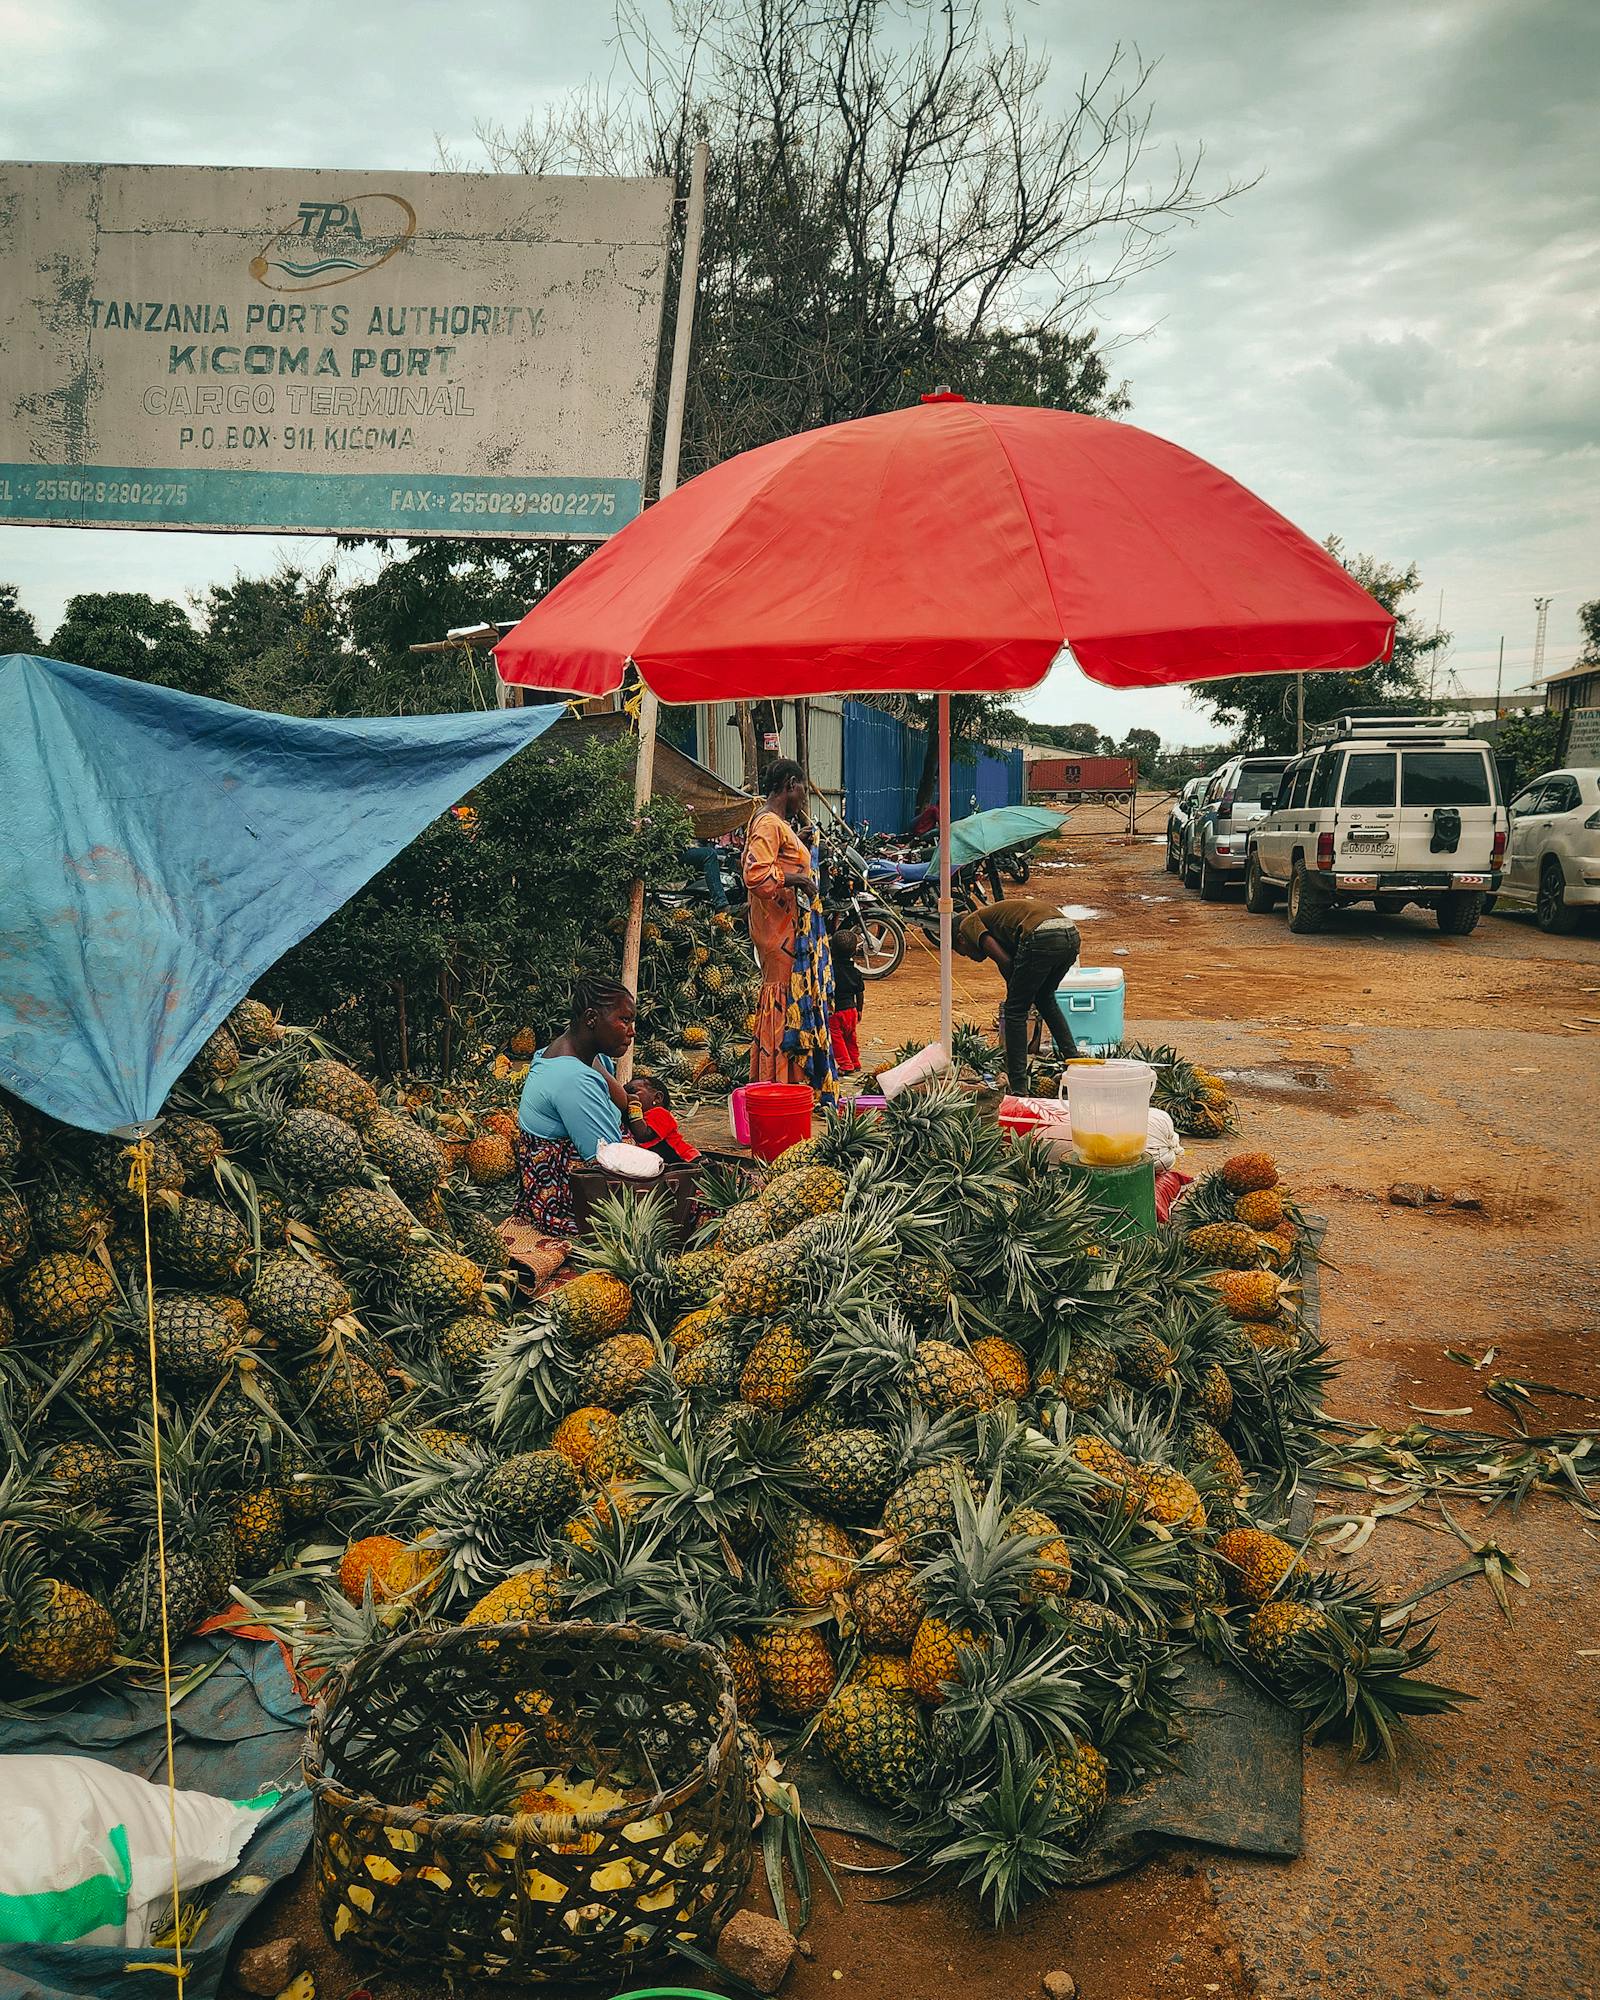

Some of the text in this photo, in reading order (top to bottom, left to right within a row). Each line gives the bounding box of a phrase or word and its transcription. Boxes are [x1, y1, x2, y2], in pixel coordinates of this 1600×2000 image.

[297, 202, 363, 240] TPA
[88, 300, 544, 337] TANZANIA PORTS AUTHORITY
[351, 346, 457, 378] PORT
[142, 383, 475, 416] CARGO TERMINAL
